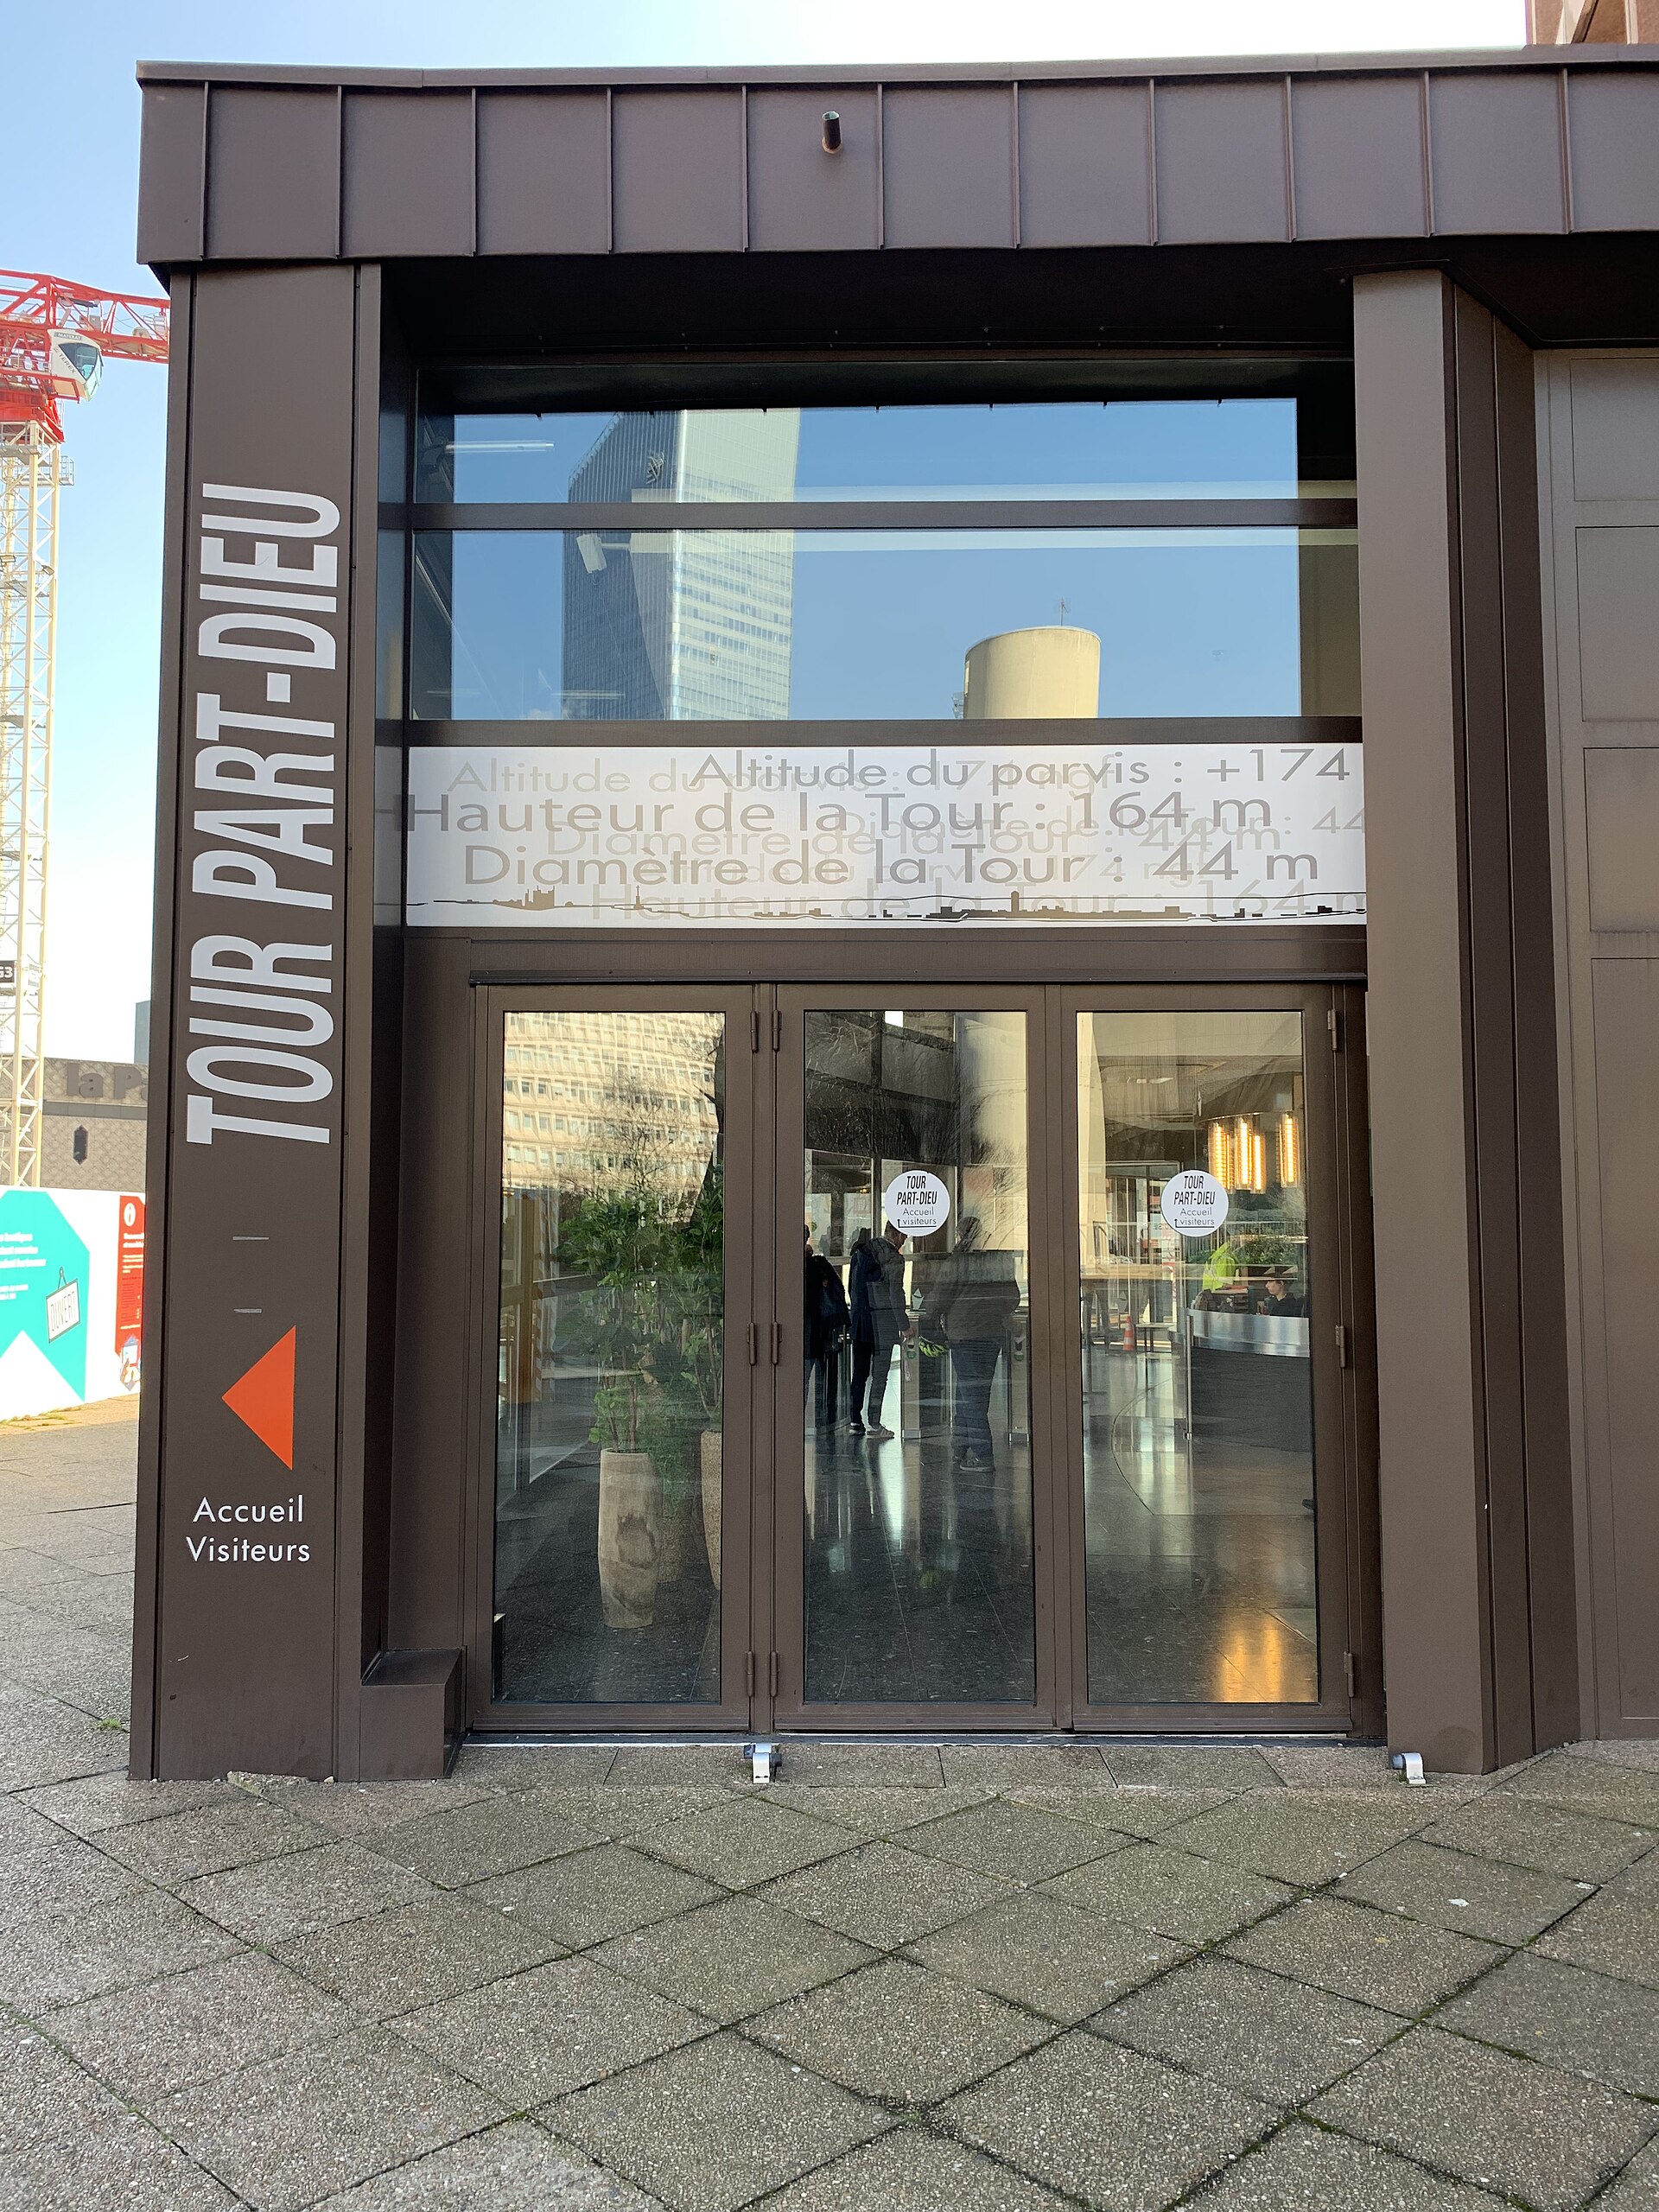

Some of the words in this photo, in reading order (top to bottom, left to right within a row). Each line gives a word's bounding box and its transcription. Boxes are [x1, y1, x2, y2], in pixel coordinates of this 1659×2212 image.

[59, 353, 76, 373] TEREX
[193, 483, 340, 910] PART-DIEU
[446, 757, 630, 792] Altitude
[689, 748, 887, 787] Altitude
[906, 748, 969, 786] du
[992, 751, 1149, 796] parvis
[1207, 747, 1351, 782] +174
[408, 793, 674, 832] Hauteur
[695, 791, 775, 832] de
[800, 791, 848, 831] la
[865, 792, 1014, 831] Tour
[1074, 791, 1189, 829] 164
[1213, 798, 1272, 828] m
[466, 844, 748, 886] Diamètre
[773, 839, 849, 886] de
[875, 839, 926, 884] la
[951, 843, 1086, 884] Tour
[1153, 839, 1238, 881] 44
[1267, 853, 1319, 880] m
[187, 934, 334, 1144] TOUR
[67, 1062, 104, 1098] la
[113, 1066, 148, 1101] P
[906, 1175, 927, 1189] TOUR
[1184, 1175, 1205, 1189] TOUR
[896, 1191, 938, 1205] PART-DIEU
[902, 1206, 934, 1216] Accueil
[1173, 1192, 1216, 1205] PART-DIEU
[1179, 1207, 1212, 1217] Accueil
[902, 1217, 937, 1225] visiteurs
[50, 1290, 76, 1332] OUVERT
[192, 1494, 304, 1523] Accueil
[186, 1535, 311, 1563] Visiteurs
